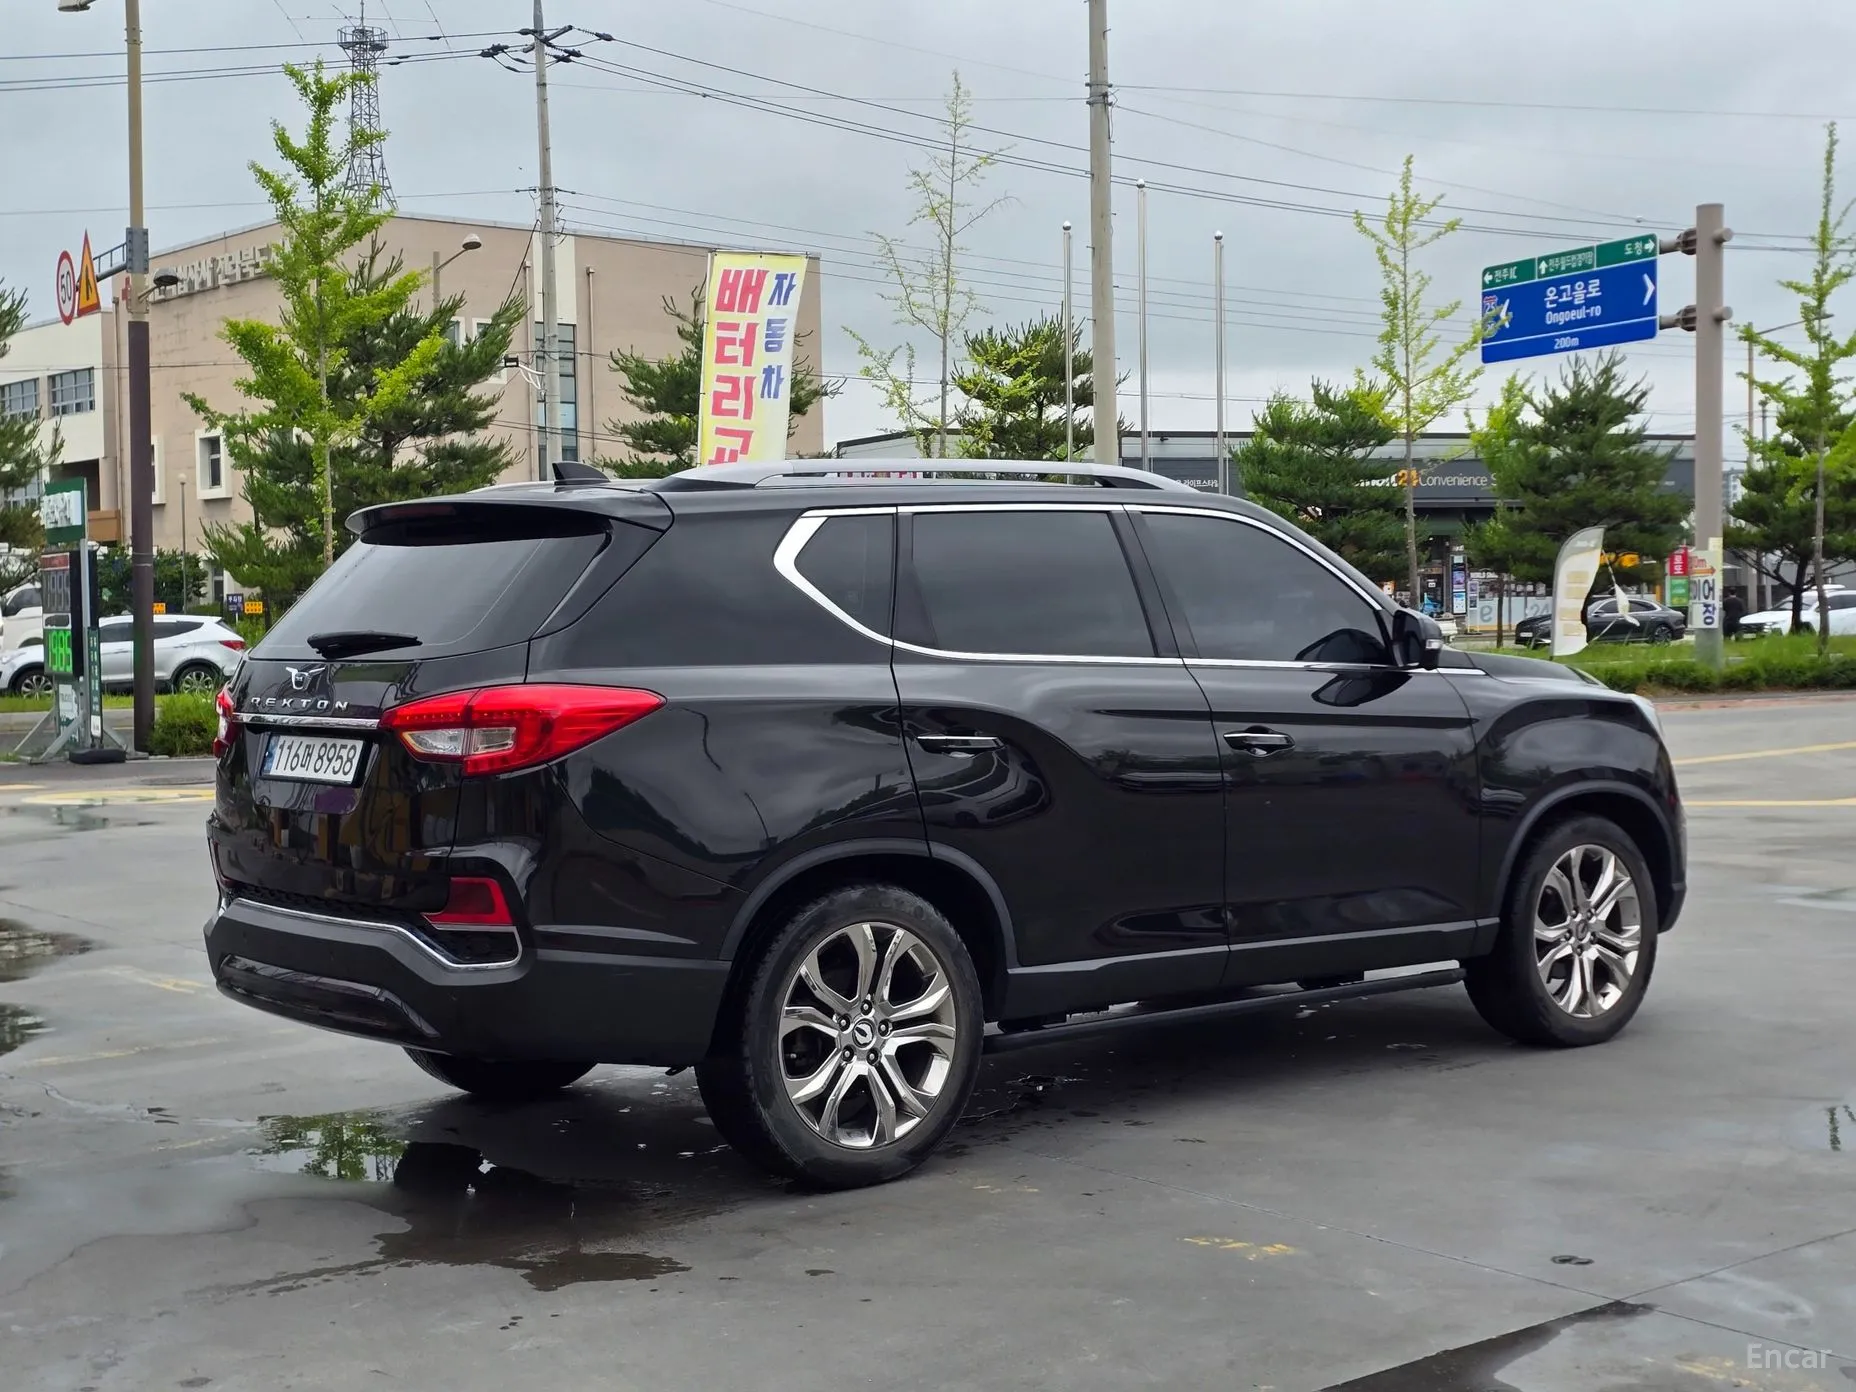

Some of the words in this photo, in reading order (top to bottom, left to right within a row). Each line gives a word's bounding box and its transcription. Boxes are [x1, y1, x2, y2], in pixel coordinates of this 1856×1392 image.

[60, 269, 72, 305] 50
[1544, 279, 1602, 309] 온고을로
[1545, 305, 1602, 326] Ongoeul-ro
[760, 272, 797, 399] 자동차
[1554, 336, 1580, 350] 200m
[1419, 473, 1488, 487] Convenience
[251, 697, 349, 710] REXTON
